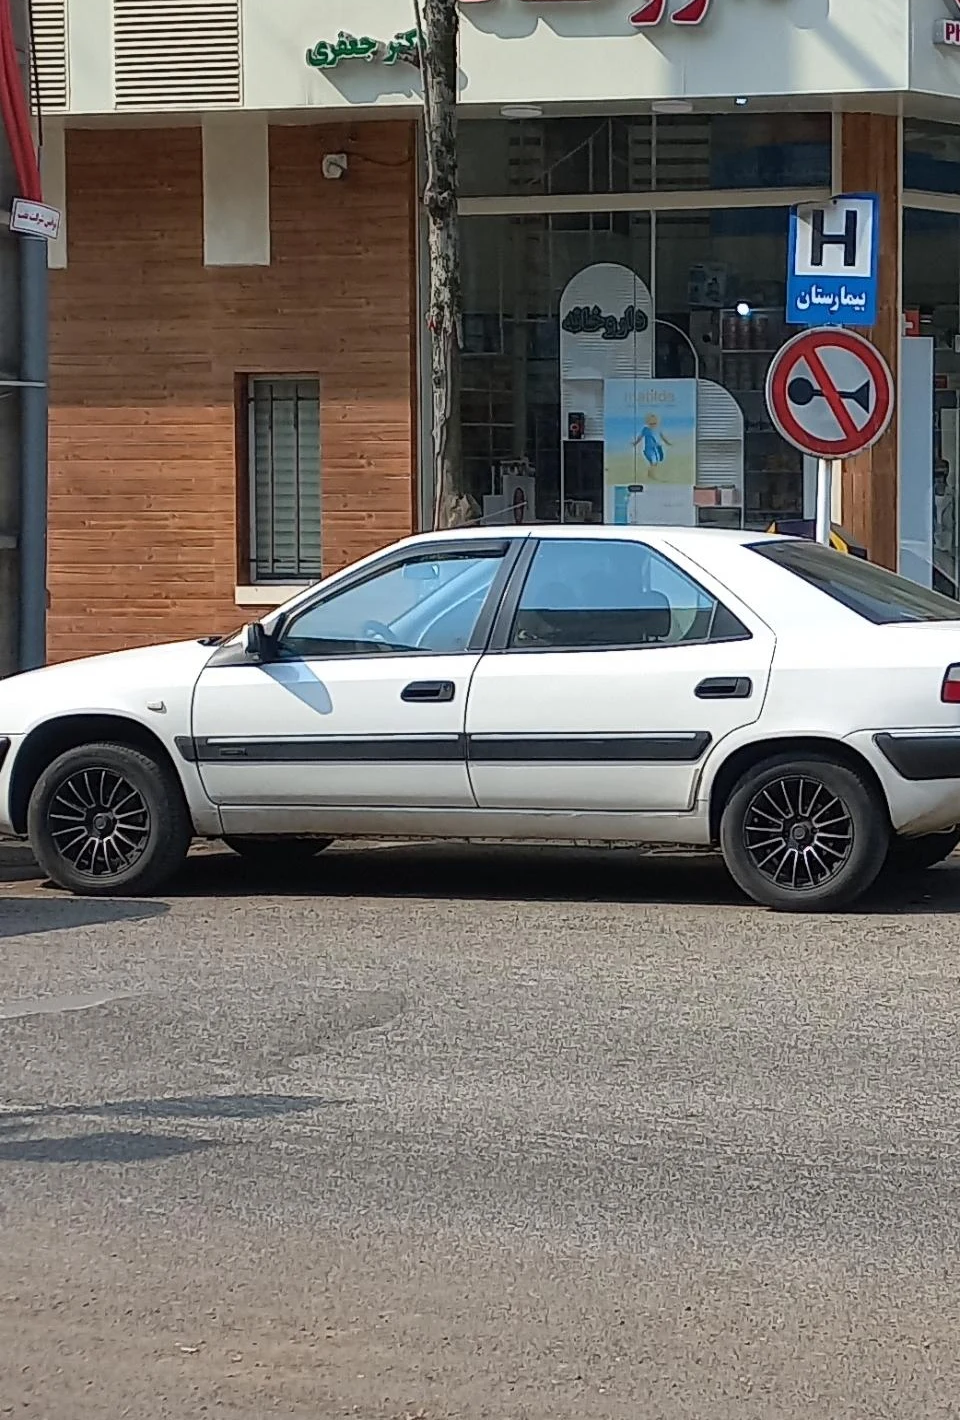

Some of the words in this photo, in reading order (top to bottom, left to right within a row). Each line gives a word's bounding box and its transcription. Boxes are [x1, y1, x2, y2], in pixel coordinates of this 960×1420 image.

[306, 31, 377, 68] جعفری
[382, 28, 428, 65] کتر
[811, 210, 857, 266] H
[796, 284, 866, 311] بیمارستان
[562, 304, 649, 340] داروخانه
